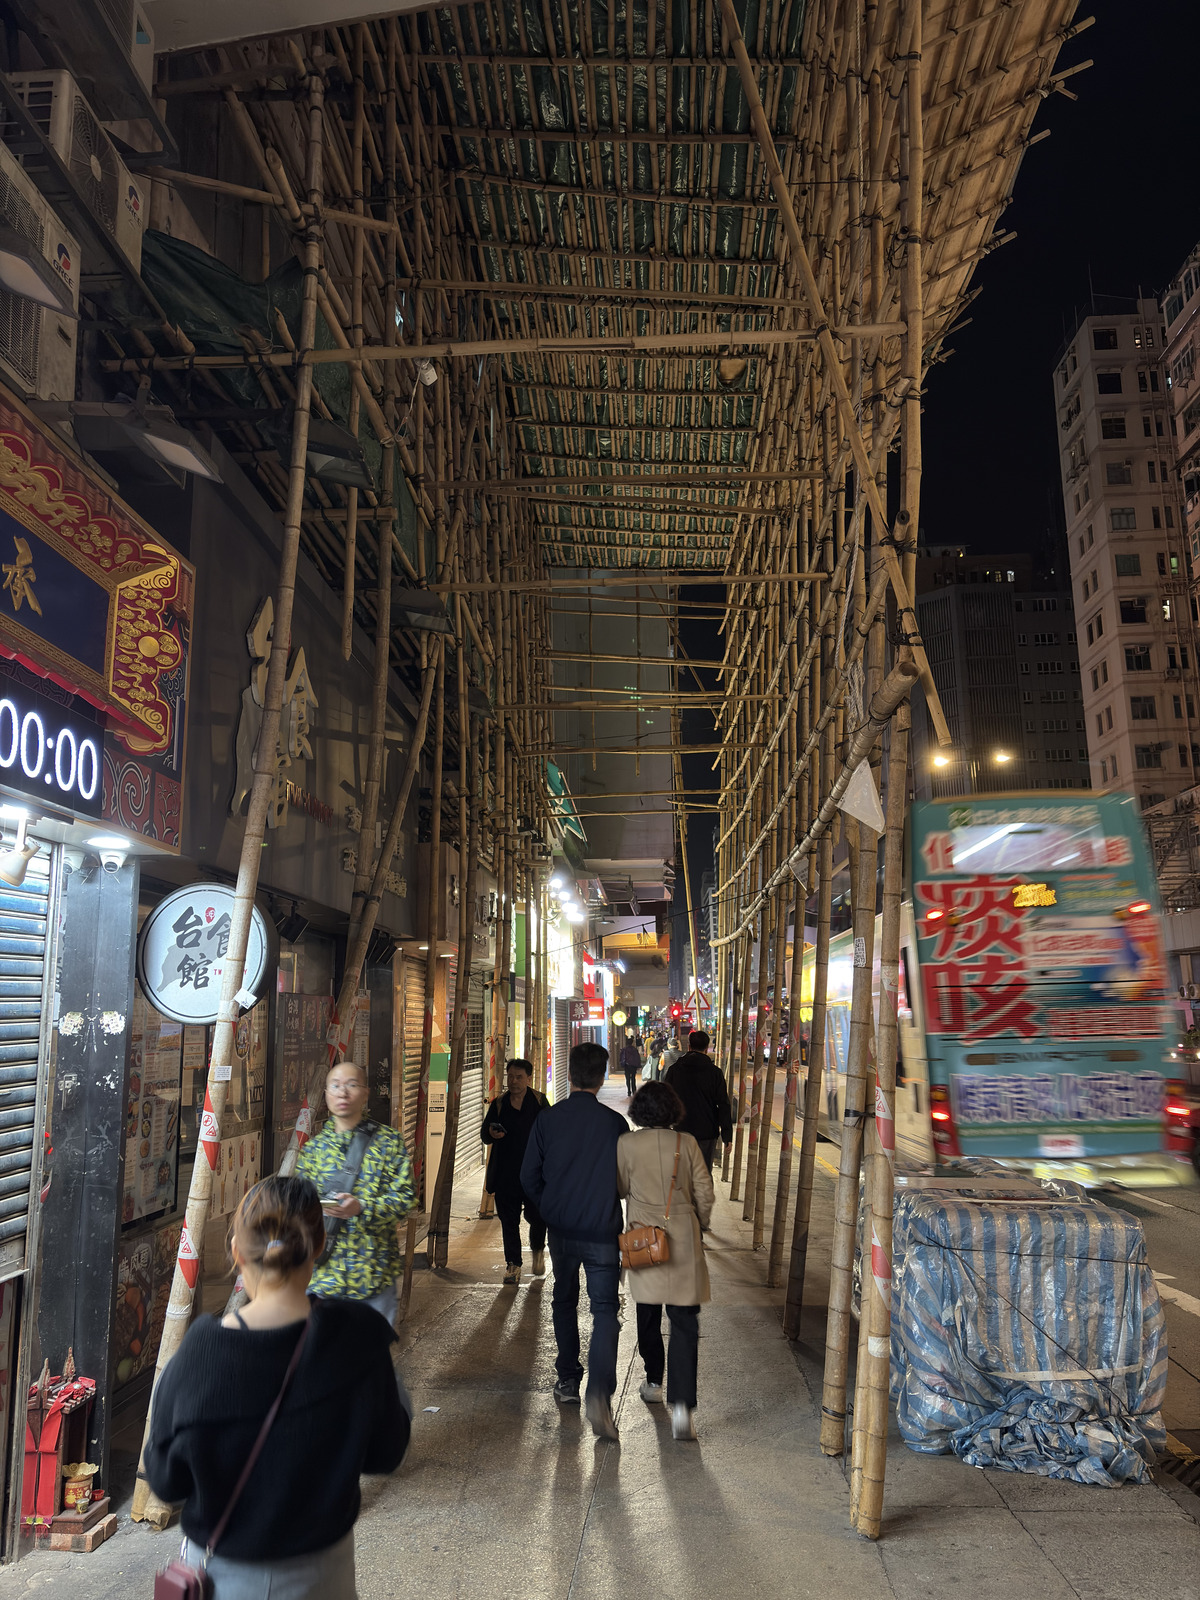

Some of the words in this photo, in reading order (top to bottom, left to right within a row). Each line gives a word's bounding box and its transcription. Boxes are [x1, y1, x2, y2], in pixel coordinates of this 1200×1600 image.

[53, 259, 75, 289] GREE
[0, 698, 98, 800] 00:00
[176, 953, 213, 990] 館
[572, 1002, 587, 1019] 藥
